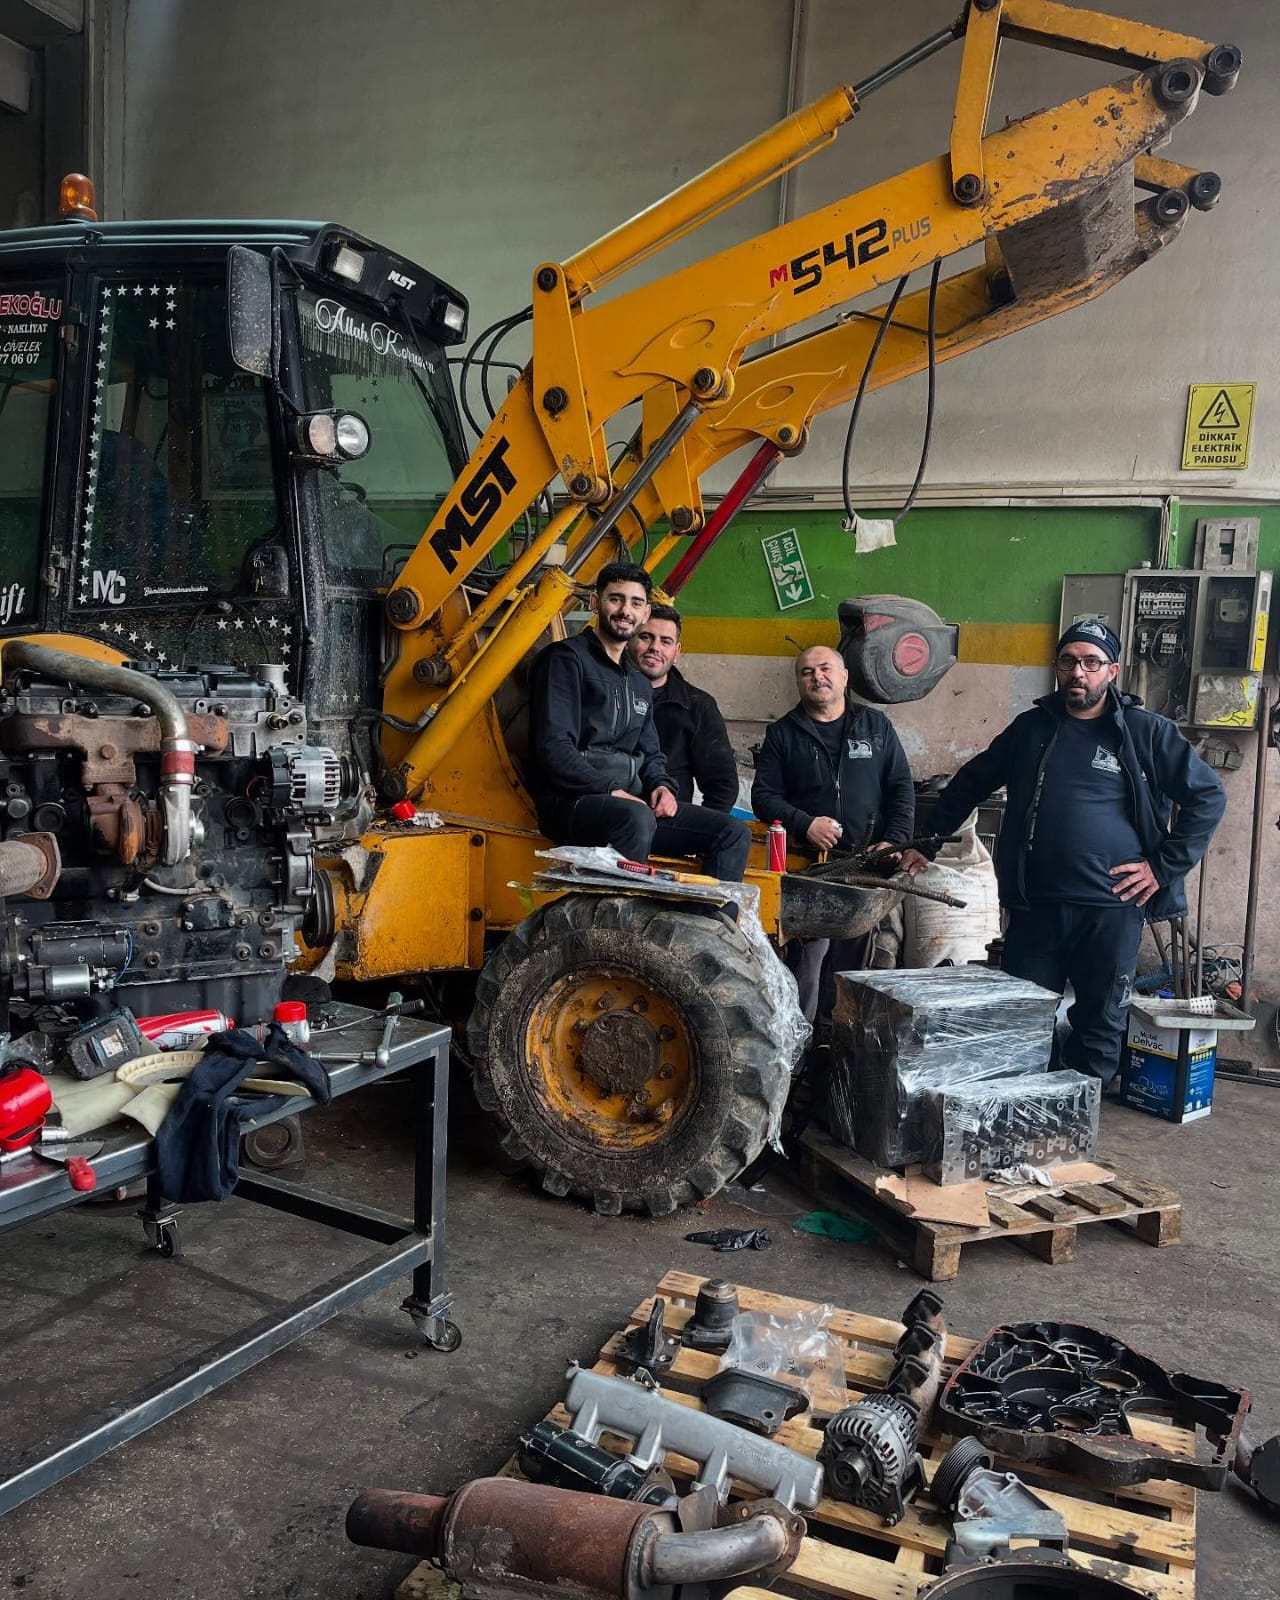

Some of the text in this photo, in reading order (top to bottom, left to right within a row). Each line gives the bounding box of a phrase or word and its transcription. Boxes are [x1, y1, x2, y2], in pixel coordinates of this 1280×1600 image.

[892, 215, 931, 249] PLUS
[387, 270, 417, 291] MST
[315, 298, 370, 343] Allah
[11, 353, 24, 365] 06
[26, 353, 40, 365] 07
[1199, 432, 1237, 441] DİKKAT
[1191, 443, 1242, 452] ELEKTRİK
[1194, 455, 1236, 463] PANOSU
[429, 435, 518, 575] MST
[766, 540, 783, 563] ÇIKIŞ
[782, 536, 797, 558] ACİL
[1133, 1034, 1164, 1051] Delvac
